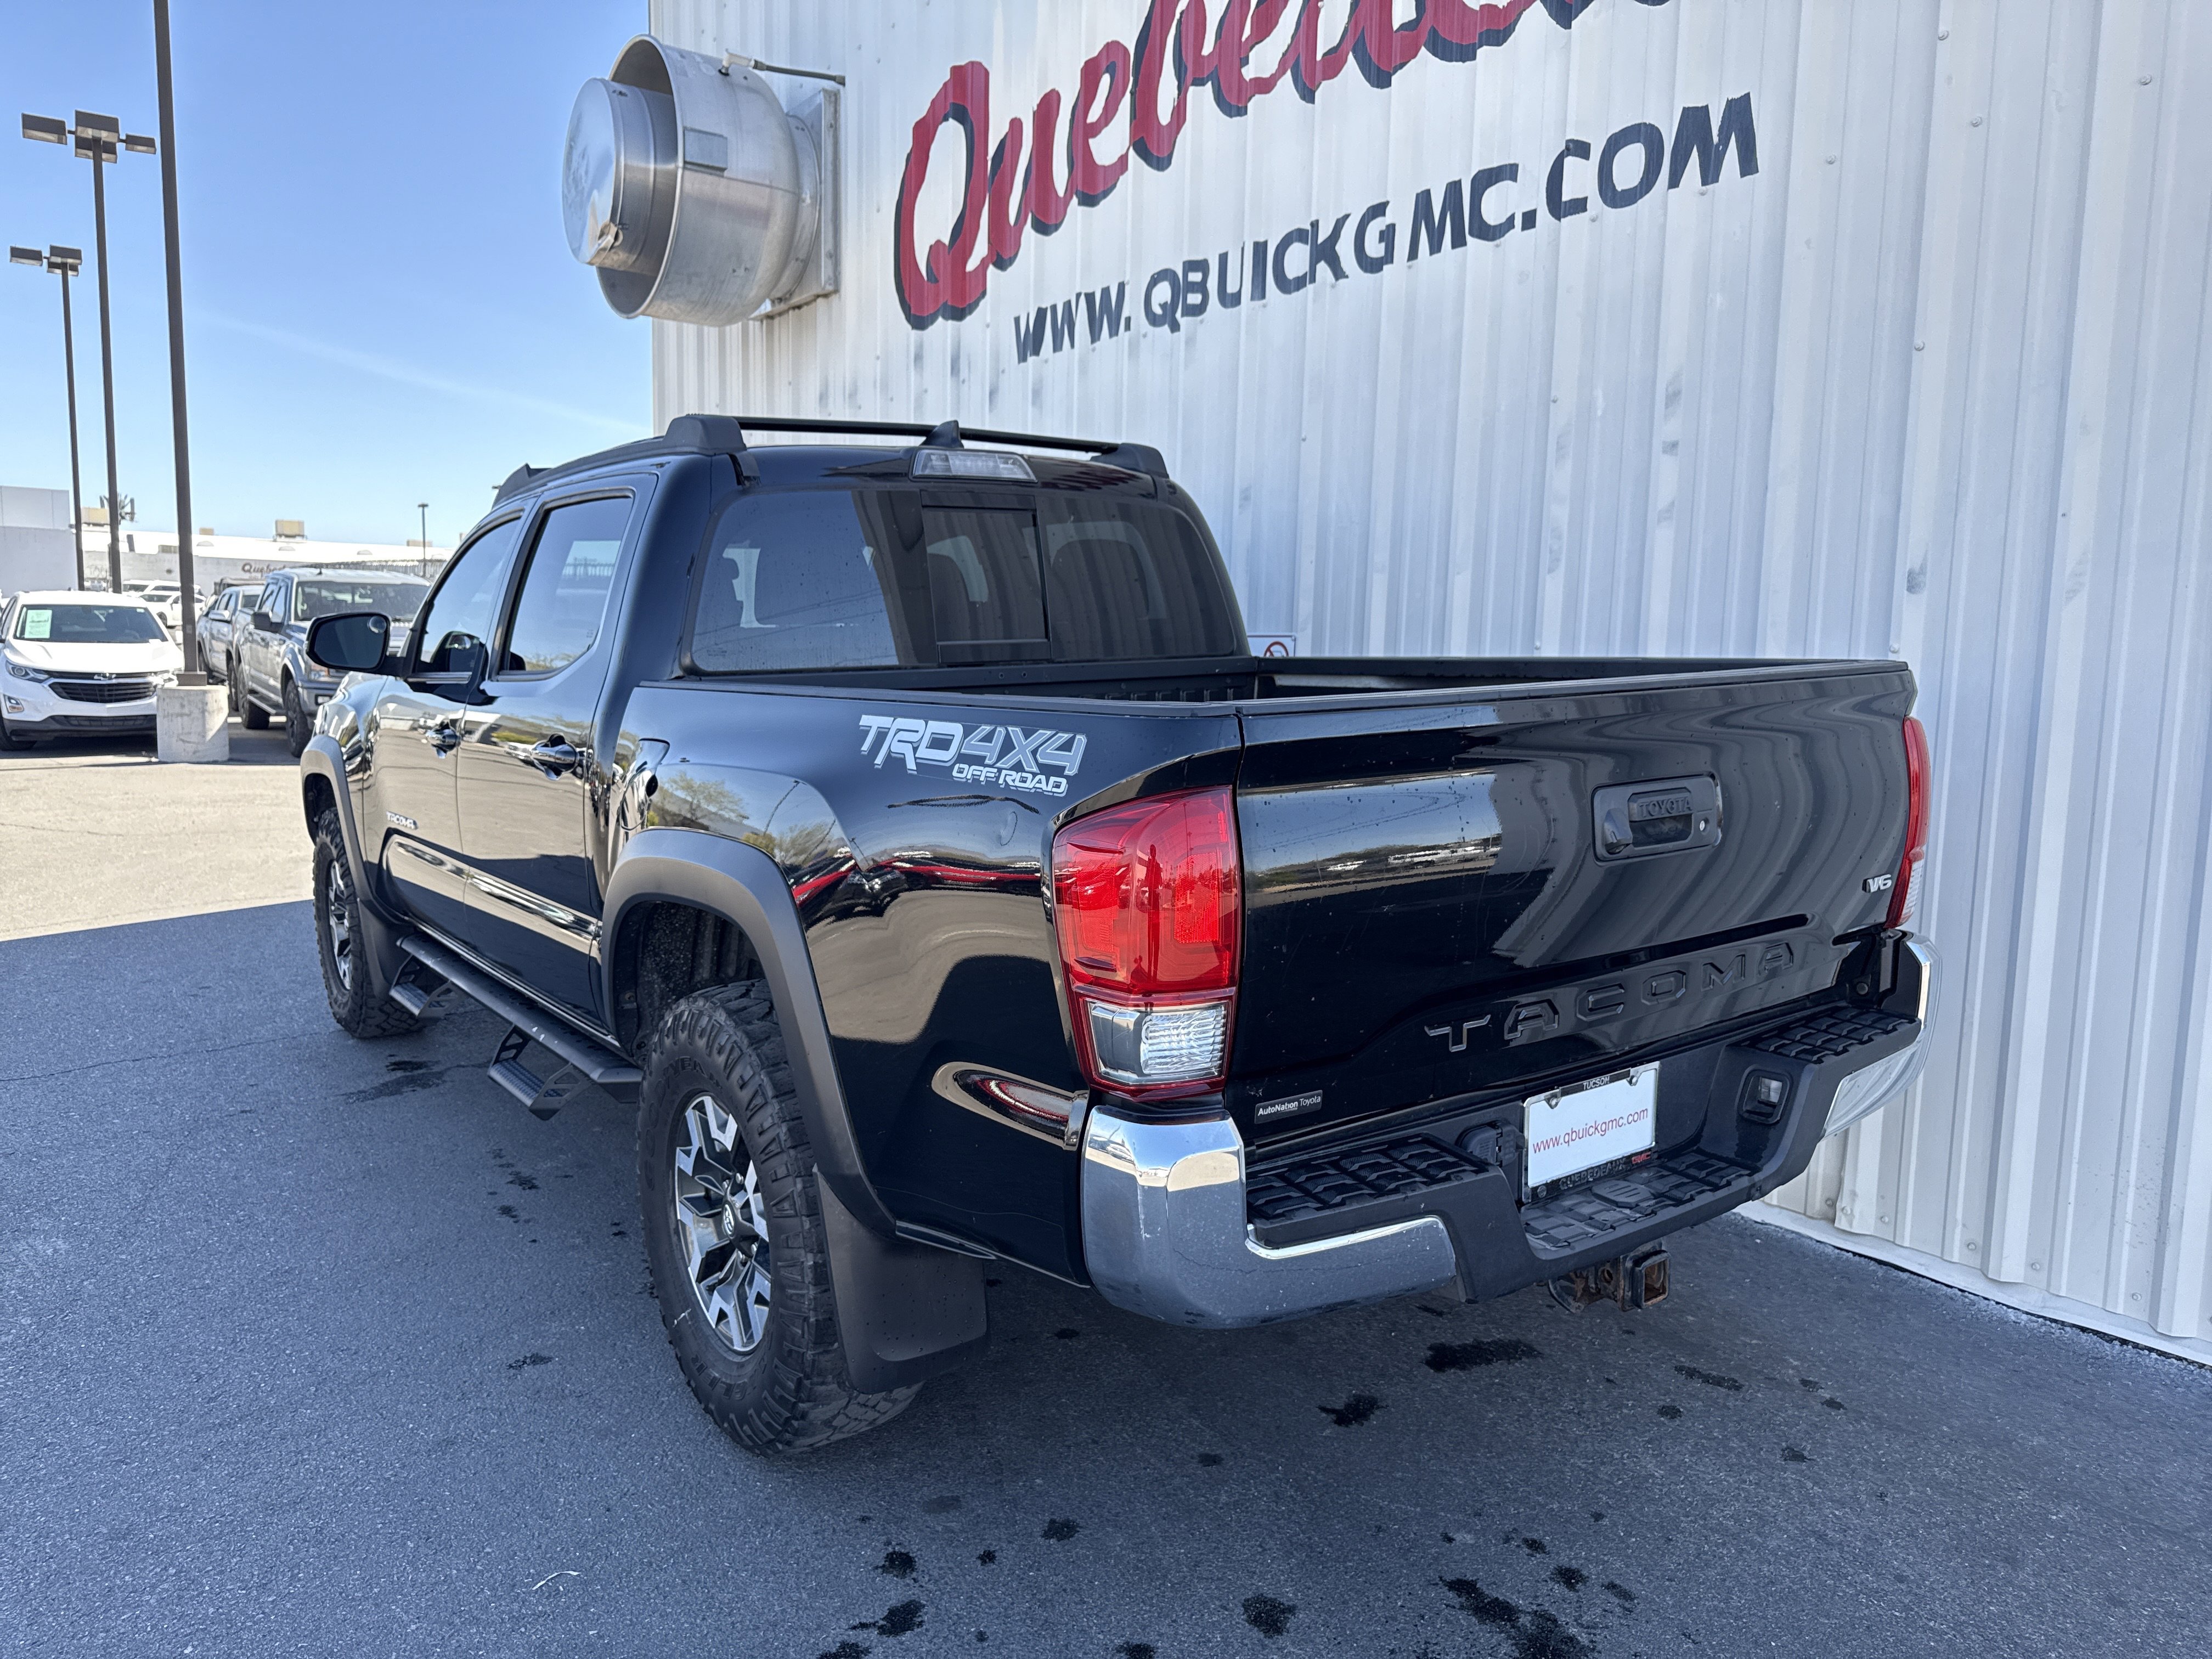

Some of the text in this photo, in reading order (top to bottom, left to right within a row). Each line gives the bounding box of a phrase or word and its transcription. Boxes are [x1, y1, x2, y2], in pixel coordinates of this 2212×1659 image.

[859, 715, 964, 775] TRD
[951, 763, 1068, 797] OFF ROAD
[1638, 796, 1693, 818] TOYOTA
[386, 811, 415, 830] TACOMA
[1866, 873, 1892, 893] V6
[1424, 942, 1795, 1052] TACOMA
[1257, 1096, 1321, 1116] AutoNation Toyota
[1532, 1108, 1648, 1154] www.qbuickgmc.com
[1632, 1152, 1651, 1165] GMC
